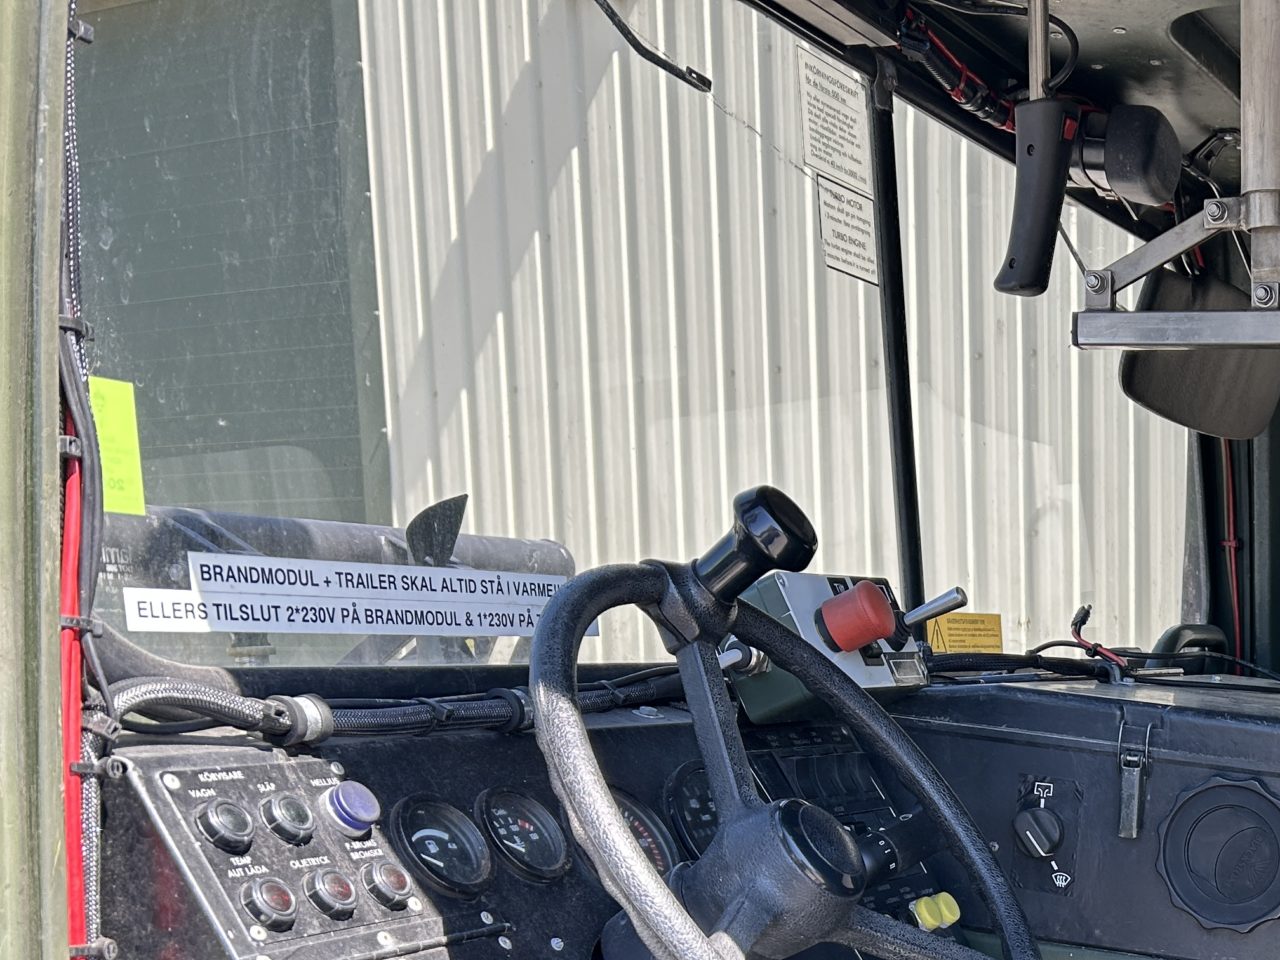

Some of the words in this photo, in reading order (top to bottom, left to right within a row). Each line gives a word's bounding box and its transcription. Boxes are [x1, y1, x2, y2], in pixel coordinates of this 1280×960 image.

[200, 564, 319, 587] BRANDMODUL
[324, 576, 332, 588] +
[335, 571, 397, 590] TRAILER
[401, 575, 437, 592] SKAL
[441, 578, 476, 594] ALTID
[480, 575, 504, 595] STÅ
[506, 581, 510, 595] I
[137, 601, 208, 619] ELLERS
[213, 603, 280, 622] TILSLUT
[341, 602, 361, 624] PÅ
[364, 608, 461, 627] BRANDMODUL
[465, 613, 474, 626] &
[518, 608, 534, 627] PÅ
[198, 770, 244, 782] KÖRVISARE
[188, 788, 216, 798] VAGN
[257, 781, 276, 793] SLÄP
[230, 856, 252, 866] TEMP
[290, 855, 330, 869] OLJETRYCK
[228, 869, 244, 878] AUT
[246, 864, 269, 874] LÅDA
